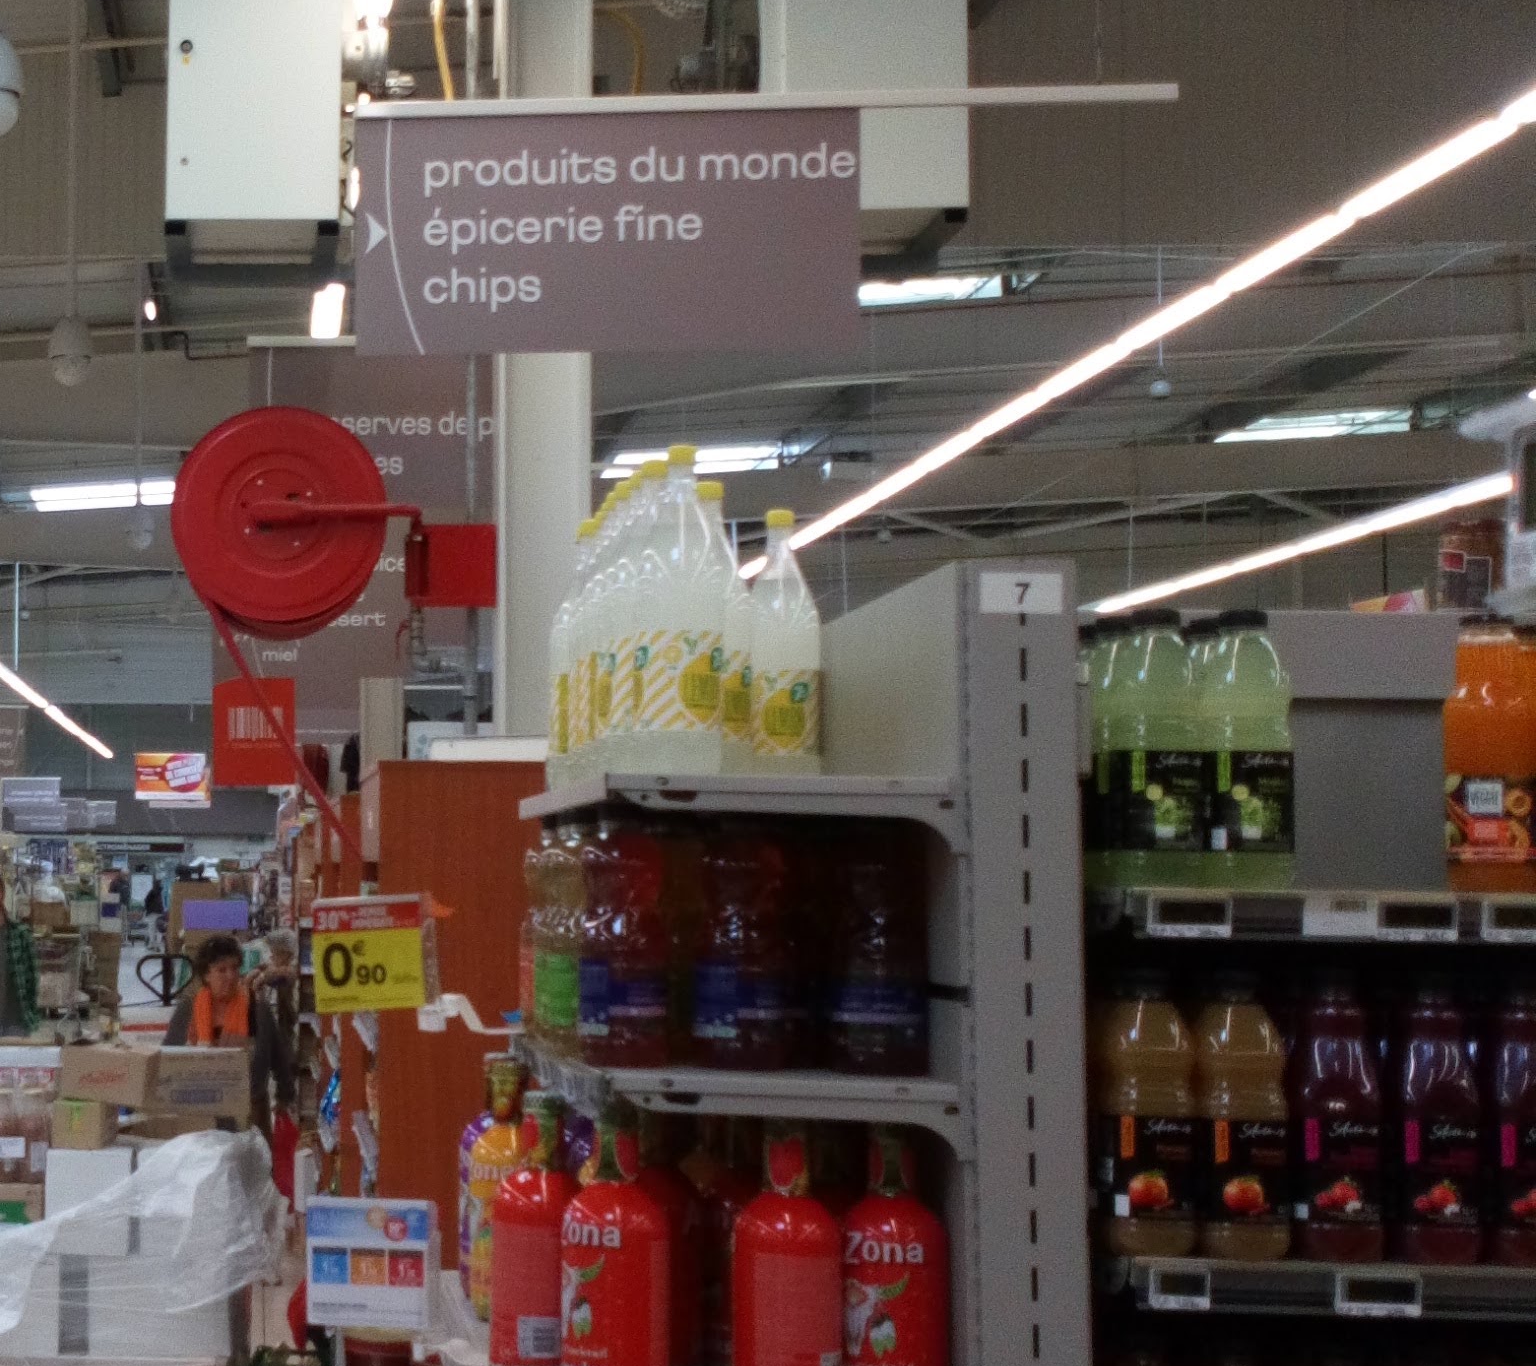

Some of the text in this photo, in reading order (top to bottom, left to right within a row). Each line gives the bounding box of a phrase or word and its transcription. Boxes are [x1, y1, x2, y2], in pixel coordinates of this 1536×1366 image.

[423, 141, 858, 195] produits du monde
[423, 203, 704, 257] épicerie fine
[423, 265, 542, 311] chips
[330, 415, 431, 435] serves
[438, 410, 468, 435] de
[1014, 582, 1031, 605] 7
[261, 647, 299, 662] miel
